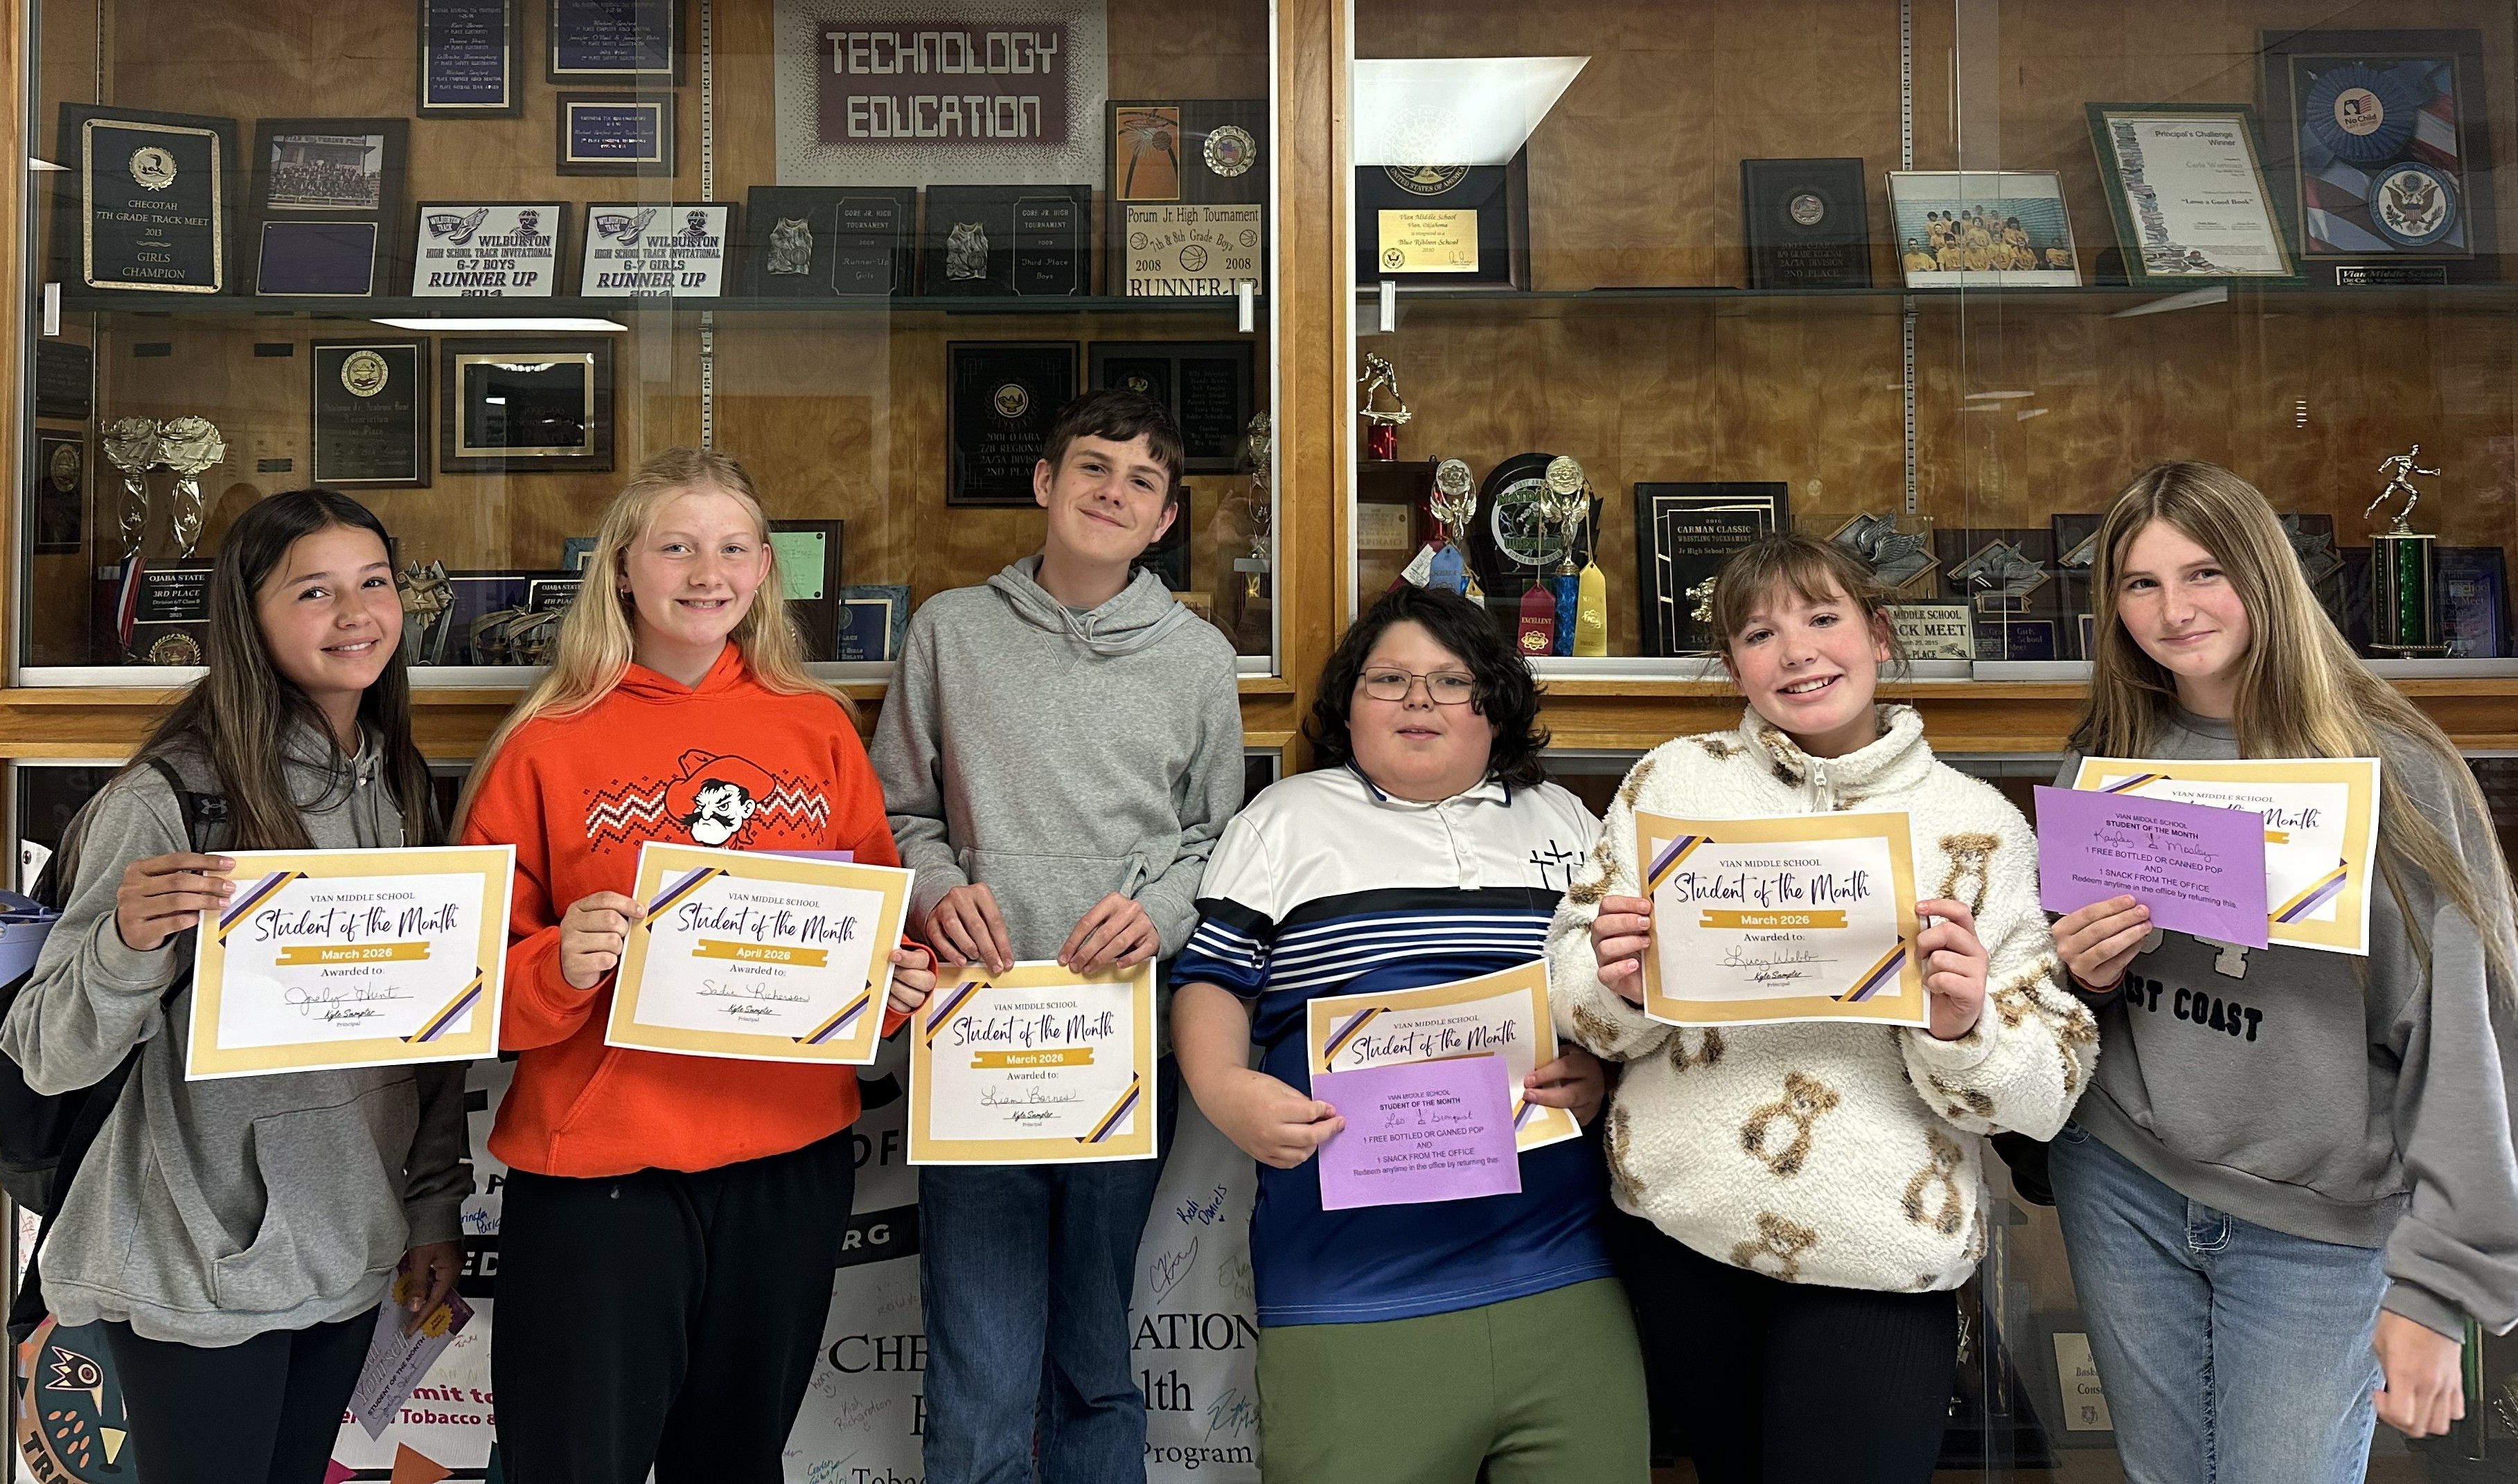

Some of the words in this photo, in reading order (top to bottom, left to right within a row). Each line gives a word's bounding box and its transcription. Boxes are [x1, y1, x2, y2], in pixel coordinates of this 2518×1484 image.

[826, 32, 1057, 73] TECHNOLOGY
[848, 96, 1040, 138] EDUCATION
[2358, 114, 2377, 123] Child
[1390, 167, 1408, 188] UNITED
[1409, 183, 1433, 193] STATES
[1434, 183, 1442, 193] OF
[1444, 166, 1466, 188] AMERICA
[128, 199, 178, 211] CHECOTAH
[96, 211, 113, 220] 7TH
[116, 213, 148, 222] GRADE
[152, 215, 181, 224] TRACK
[184, 217, 209, 226] MEET
[1128, 208, 1158, 223] Porum
[1177, 207, 1198, 226] High
[1203, 207, 1259, 222] Tournament
[145, 228, 162, 236] 2013
[479, 235, 551, 247] WILBURTON
[646, 235, 720, 248] WILBURTON
[1150, 238, 1165, 253] 7th
[1164, 234, 1172, 245] &
[1172, 229, 1186, 244] 8th
[1190, 229, 1213, 243] Grade
[1216, 233, 1234, 252] Boys
[137, 252, 170, 262] GIRLS
[426, 248, 443, 258] HIGH
[446, 248, 472, 258] SCHOOL
[475, 248, 499, 258] TRACK
[500, 248, 552, 258] INVITATIONAL
[594, 249, 612, 259] HIGH
[614, 249, 639, 259] SCHOOL
[643, 249, 666, 258] TRACK
[456, 260, 479, 270] 6-7
[483, 259, 516, 270] BOYS
[623, 260, 646, 271] 6-7
[649, 260, 686, 271] GIRLS
[842, 257, 889, 267] Runner-Up
[1135, 260, 1162, 271] 2008
[1226, 258, 1251, 270] 2008
[122, 267, 186, 278] CHAMPION
[428, 271, 506, 287] RUNNER
[512, 271, 538, 287] UP
[596, 272, 675, 288] RUNNER
[680, 272, 707, 287] UP
[1893, 610, 1926, 620] MIDDLE
[1927, 610, 1962, 620] SCHOOL
[1924, 624, 1967, 636] MEET
[1913, 650, 1937, 659] PLACE
[2172, 789, 2195, 798] VIAN
[2196, 792, 2234, 801] MIDDLE
[2235, 794, 2275, 803] SCHOOL
[2261, 808, 2321, 830] Month
[2106, 821, 2140, 830] STUDENT
[2171, 829, 2199, 839] MONTH
[1783, 859, 1823, 867] SCHOOL
[2091, 848, 2113, 856] FREE
[2116, 850, 2152, 862] BOTTLED
[2169, 859, 2204, 871] CANNED
[2205, 865, 2223, 874] POP
[2105, 869, 2133, 879] SNACK
[2135, 873, 2159, 884] FROM
[2161, 877, 2177, 886] THE
[2179, 881, 2210, 893] OFFICE
[1674, 872, 1757, 903] Student
[1753, 875, 1772, 908] of
[1770, 873, 1804, 900] the
[1811, 870, 1871, 906] Month
[309, 894, 334, 903] VIAN
[336, 893, 374, 902] MIDDLE
[376, 892, 416, 901] SCHOOL
[728, 893, 750, 902] VIAN
[750, 895, 785, 906] MIDDLE
[786, 897, 820, 908] SCHOOL
[255, 907, 343, 943] Student
[340, 910, 362, 942] of
[359, 907, 392, 935] the
[398, 903, 459, 937] Month
[677, 902, 759, 935] Student
[750, 914, 768, 940] of
[769, 908, 797, 939] the
[801, 915, 857, 944] Month
[1741, 915, 1777, 925] March
[1780, 915, 1810, 925] 2026
[1744, 933, 1789, 942] Awarded
[321, 948, 360, 960] March
[362, 947, 393, 959] 2026
[736, 947, 762, 960] April
[763, 949, 791, 961] 2026
[320, 967, 369, 977] Awarded
[729, 965, 772, 976] Awarded
[1046, 1001, 1078, 1009] SCHOOL
[2174, 987, 2263, 1042] COAST
[952, 1016, 1024, 1046] Student
[1019, 1019, 1036, 1048] of
[1034, 1015, 1061, 1038] the
[1066, 1011, 1115, 1044] Month
[1351, 1032, 1424, 1065] Student
[1419, 1035, 1437, 1057] of
[1436, 1028, 1462, 1051] the
[1466, 1019, 1516, 1051] Month
[1007, 1054, 1038, 1064] March
[1039, 1054, 1063, 1063] 2026
[1007, 1072, 1046, 1080] Awarded
[1131, 1314, 1259, 1350] ATION
[400, 1409, 481, 1424] Tobacco
